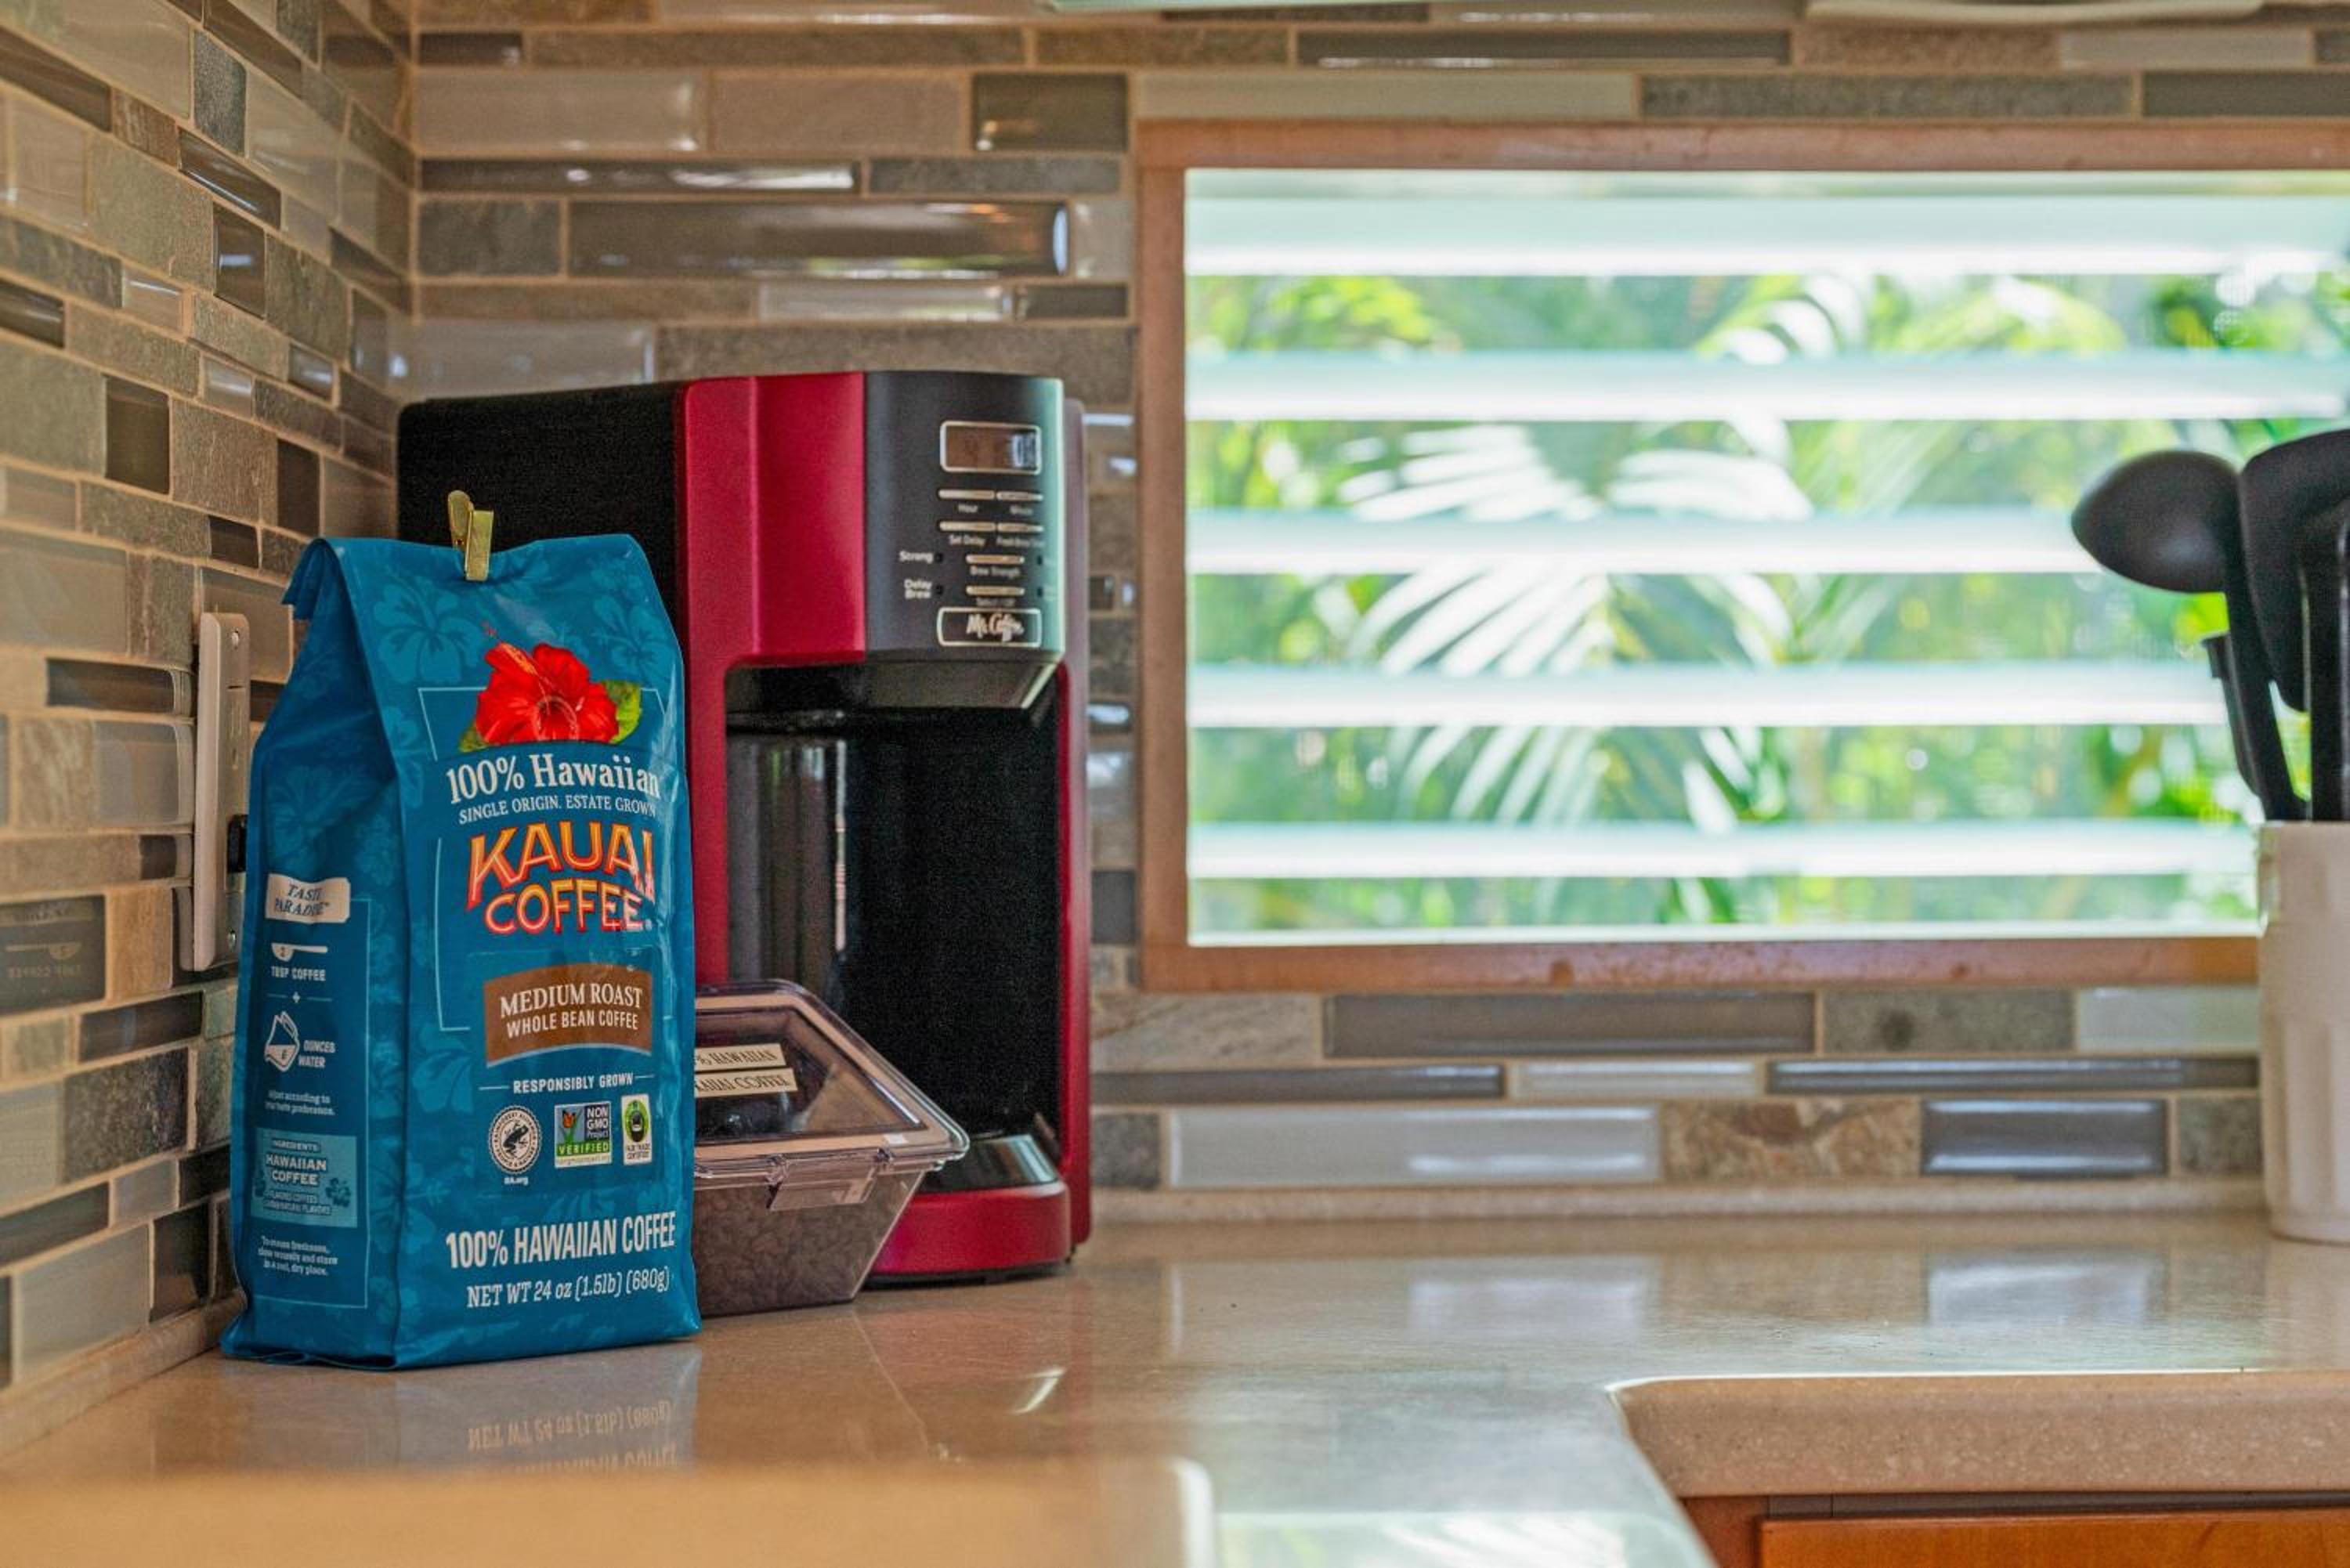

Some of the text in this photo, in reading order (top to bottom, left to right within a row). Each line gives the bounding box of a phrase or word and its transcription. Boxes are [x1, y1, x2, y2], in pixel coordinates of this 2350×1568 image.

[899, 551, 934, 564] Strong
[904, 579, 932, 591] Delay
[446, 753, 660, 804] 100% Hawaiian
[459, 797, 508, 825] SINGLE
[566, 794, 612, 810] ESTATE
[615, 797, 656, 818] GROWN
[465, 820, 655, 911] KAUAI
[484, 878, 645, 934] COFFEE
[291, 967, 326, 981] COFFEE
[501, 982, 643, 1018] MEDIUM ROAST
[507, 1010, 638, 1039] WHOLE BEAN COFFEE
[298, 1055, 326, 1068] WATER
[513, 1073, 634, 1094] RESPONSIBLY GROWN
[588, 1107, 609, 1118] NON
[588, 1118, 609, 1129] GMO
[559, 1143, 609, 1155] VERIFIED
[266, 1154, 327, 1172] HAWAIIAN
[272, 1170, 319, 1186] COFFEE
[446, 1211, 676, 1269] 100% HAWAIIAN COFFEE
[467, 1266, 670, 1308] NET WT 24 oz (1.5lb) (680g)
